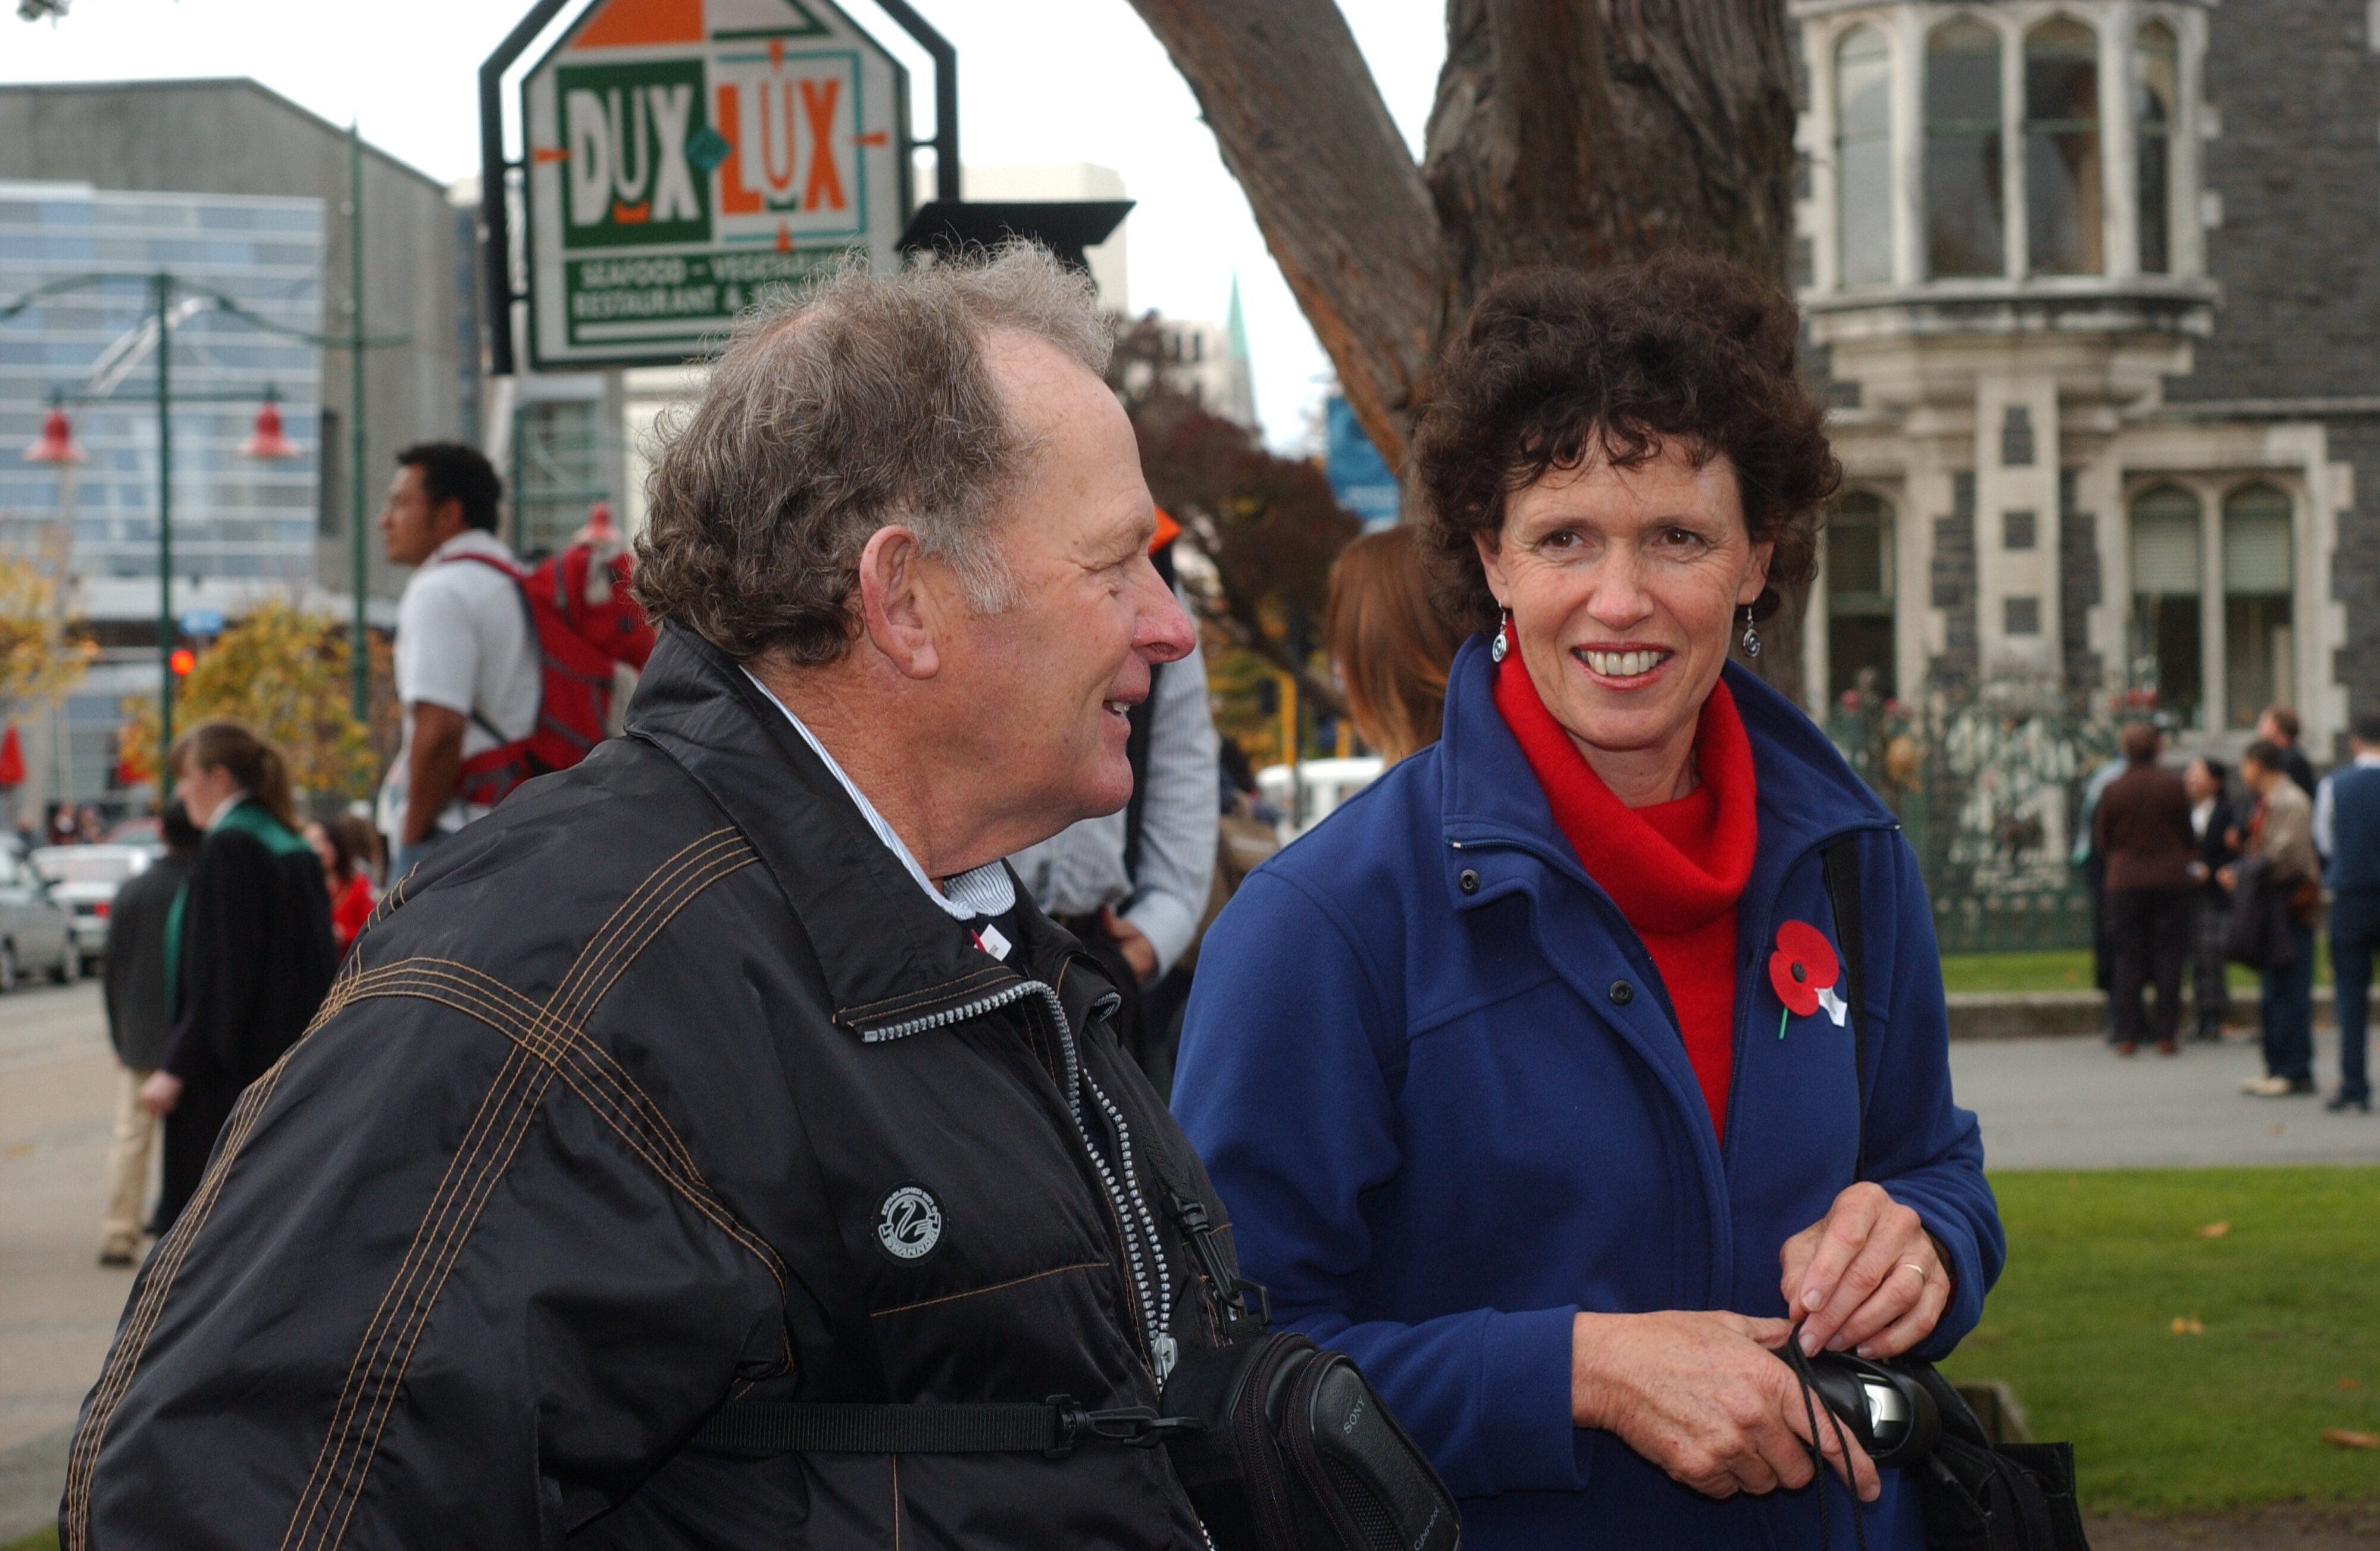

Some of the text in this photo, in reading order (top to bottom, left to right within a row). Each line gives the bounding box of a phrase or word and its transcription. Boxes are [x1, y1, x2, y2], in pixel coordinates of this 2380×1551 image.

[565, 78, 847, 227] DUX LUX
[581, 258, 687, 287] SEAFOOD
[574, 285, 717, 317] RESTAURANT
[884, 1228, 939, 1258] SWANNDRI
[1343, 1393, 1365, 1435] SONY
